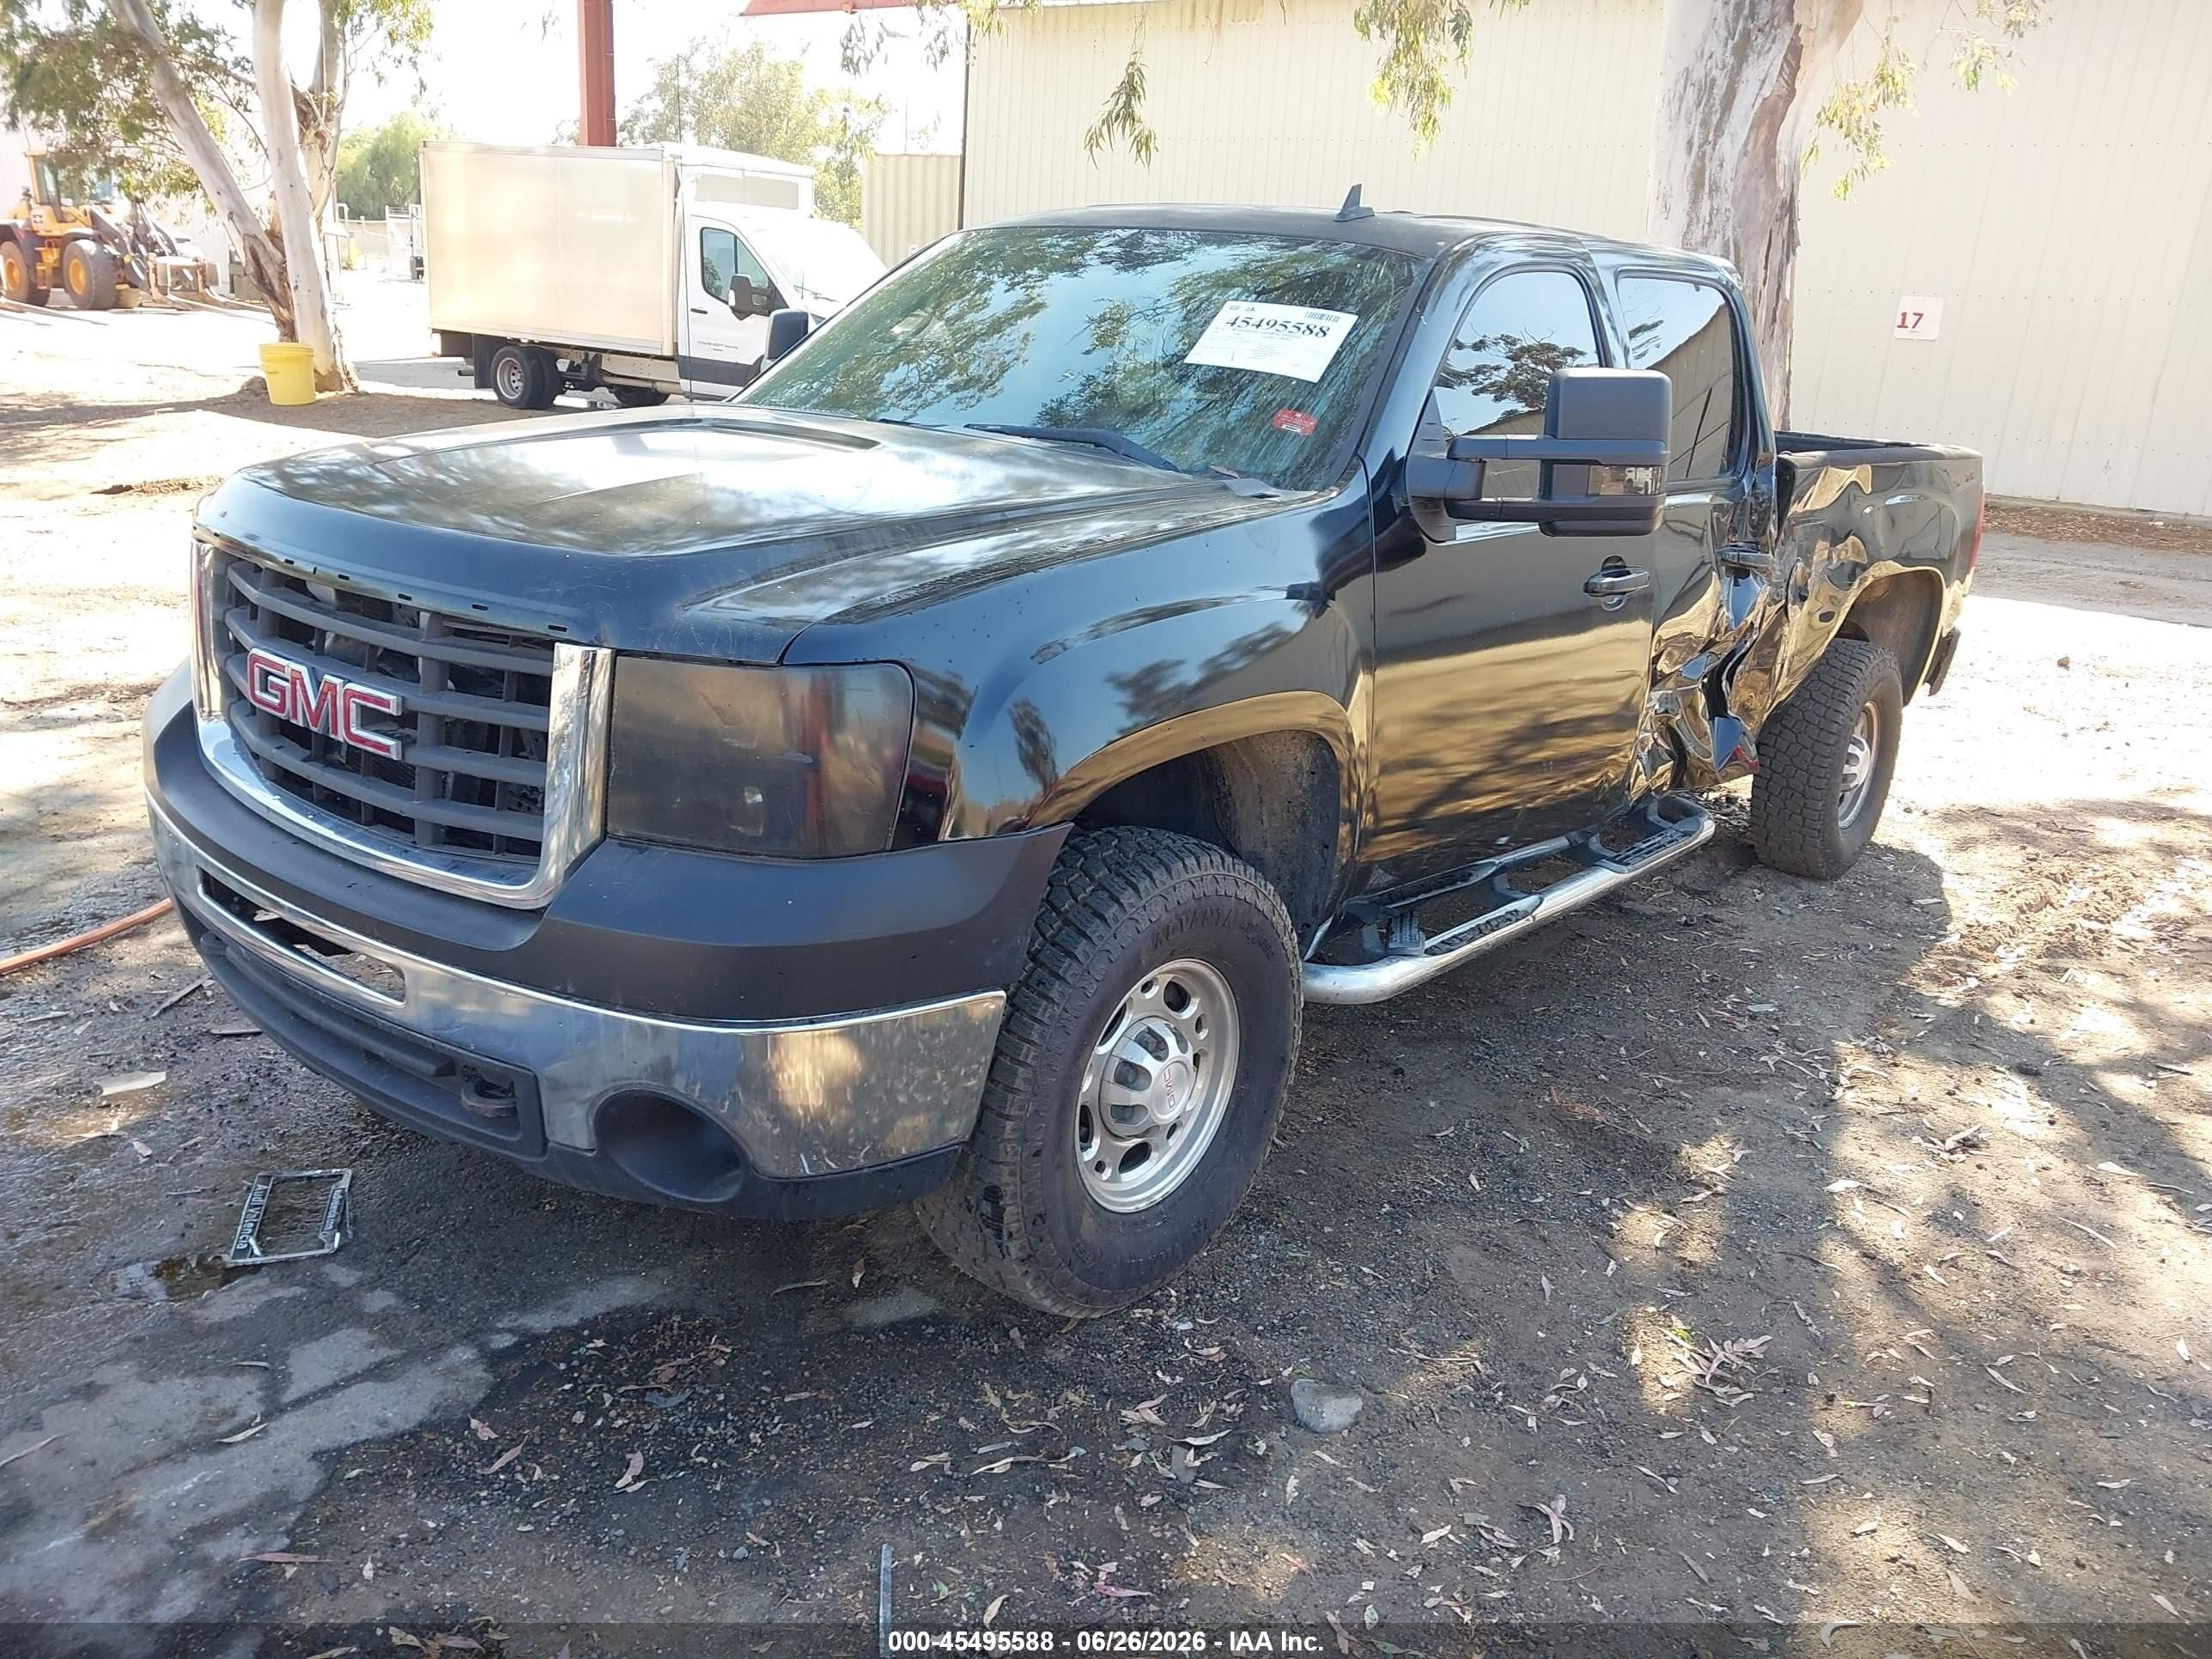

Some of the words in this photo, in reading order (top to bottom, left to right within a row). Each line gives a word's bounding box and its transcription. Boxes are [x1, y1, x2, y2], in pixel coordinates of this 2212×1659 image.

[1225, 316, 1330, 338] 45495588
[1896, 312, 1924, 329] 17
[247, 647, 403, 761] GMC
[1164, 1068, 1176, 1109] GMC
[249, 1184, 269, 1205] Audi
[236, 1206, 262, 1249] Valencia
